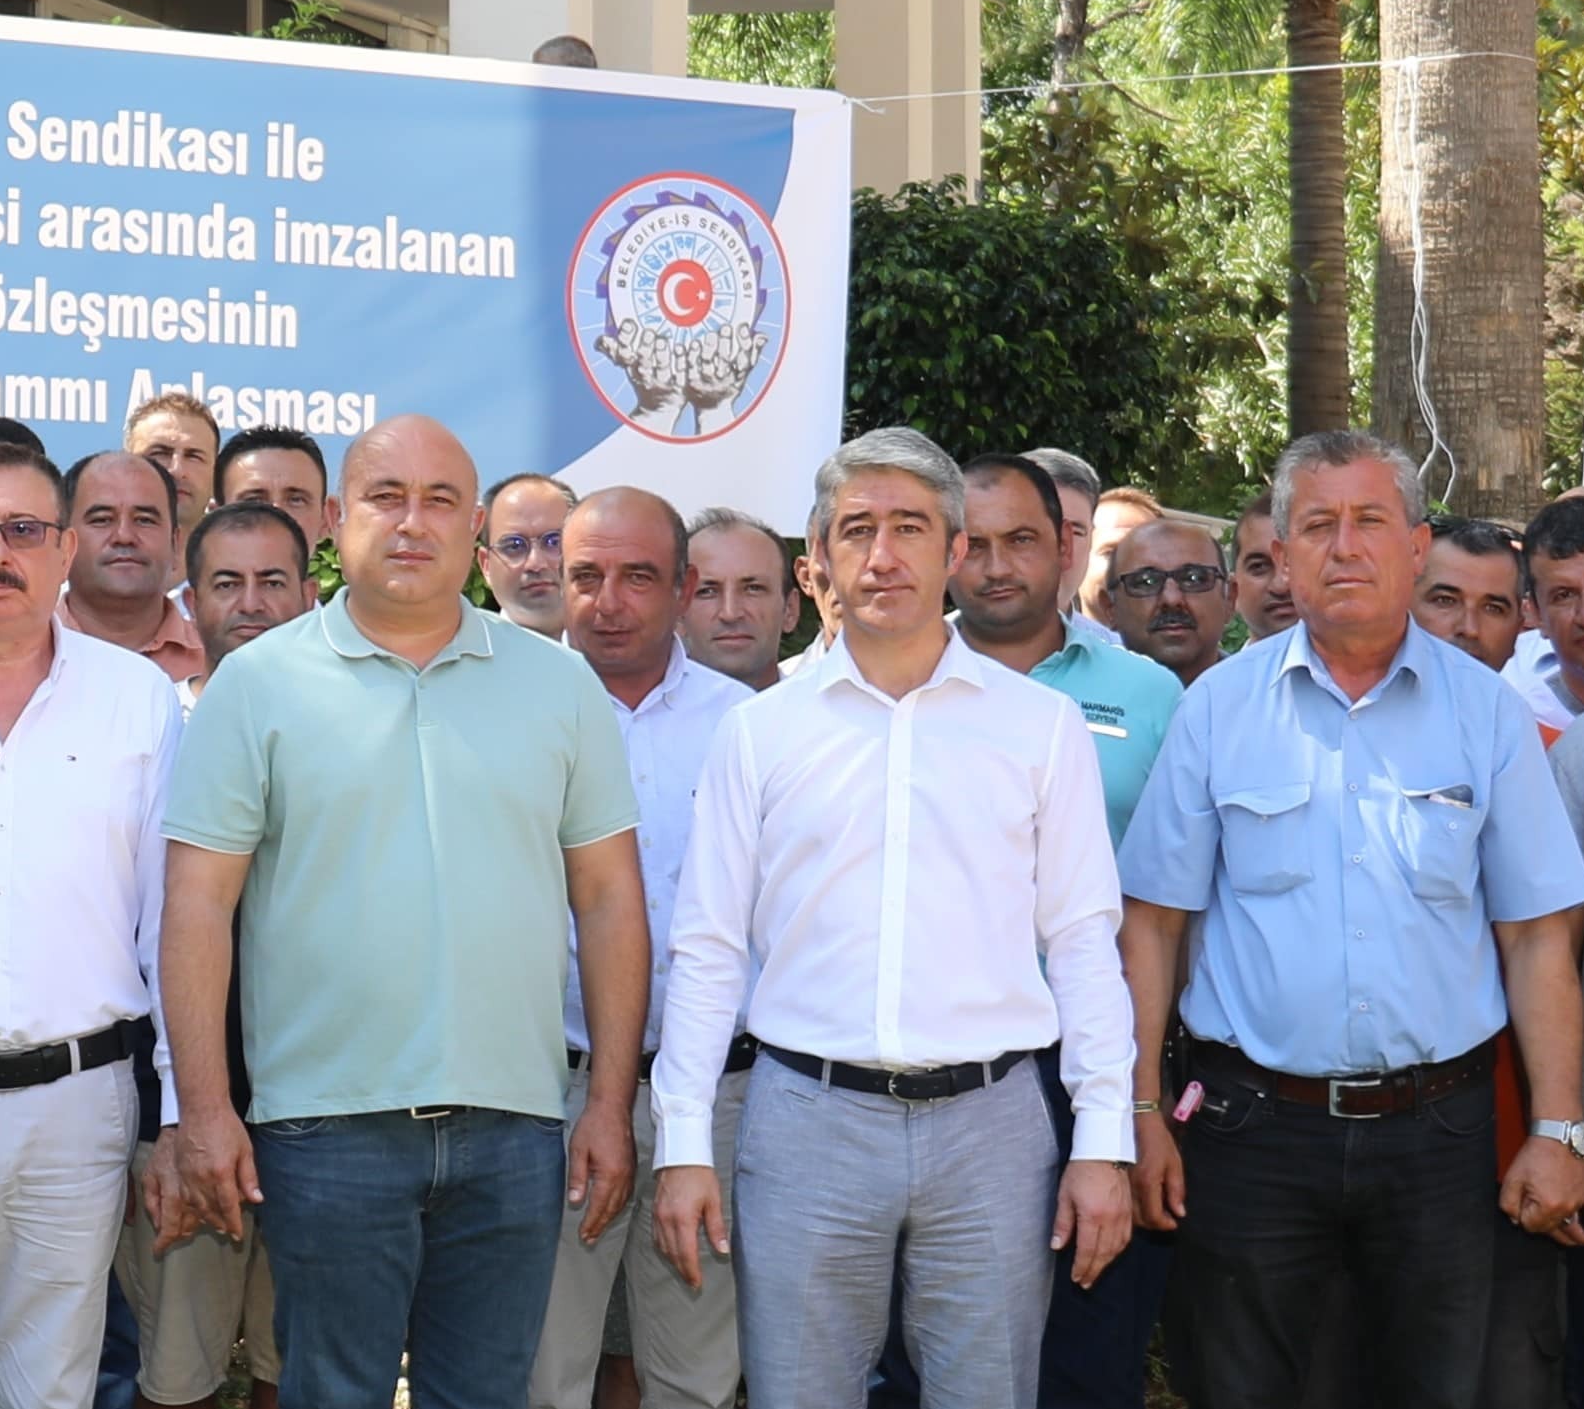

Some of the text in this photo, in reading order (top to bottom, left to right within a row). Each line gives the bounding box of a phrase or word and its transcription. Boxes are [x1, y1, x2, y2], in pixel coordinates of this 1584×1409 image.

[6, 99, 249, 176] Sendikası
[266, 121, 324, 182] ile
[38, 201, 256, 262] arasında
[274, 206, 516, 278] imzalanan
[699, 217, 752, 299] SENDİKASI
